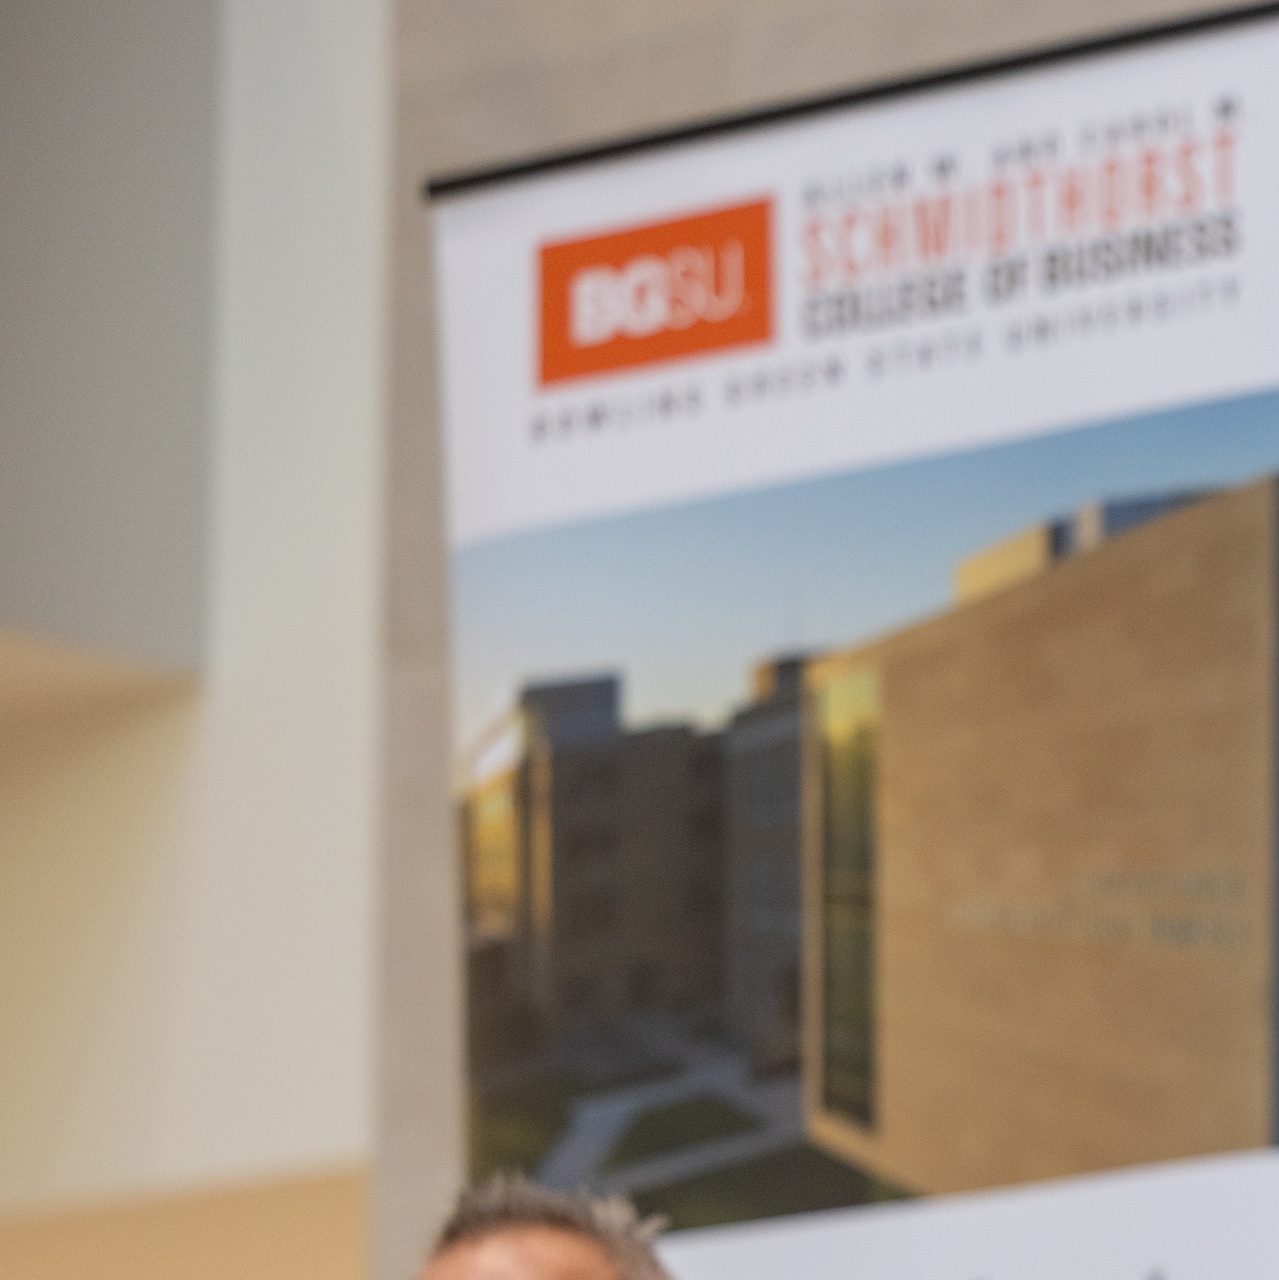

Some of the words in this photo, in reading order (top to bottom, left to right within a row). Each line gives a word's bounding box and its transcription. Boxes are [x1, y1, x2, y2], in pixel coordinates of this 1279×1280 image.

[803, 122, 1238, 292] SCHMIDTHORST
[566, 237, 746, 350] BGSU
[803, 267, 966, 342] COLLEGE
[985, 253, 1028, 310] OF
[1043, 208, 1241, 300] BUSINESS
